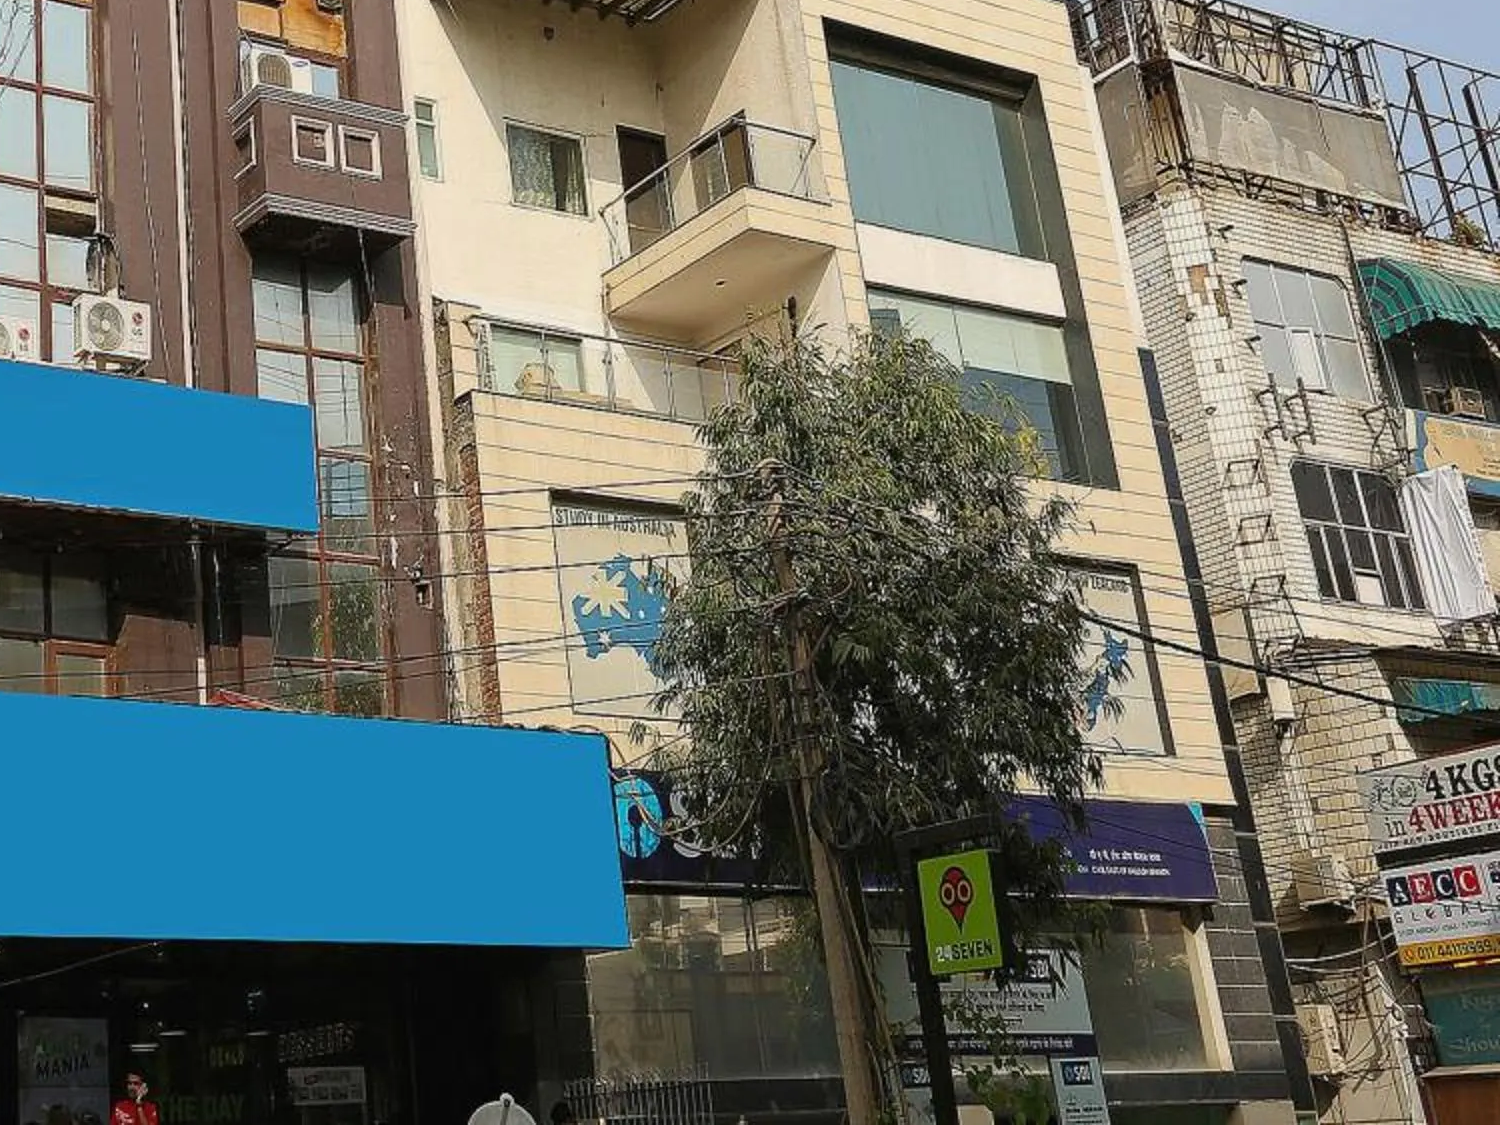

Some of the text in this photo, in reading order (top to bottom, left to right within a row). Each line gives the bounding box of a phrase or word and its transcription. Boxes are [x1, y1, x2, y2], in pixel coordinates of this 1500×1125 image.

[1385, 816, 1407, 838] in
[1390, 867, 1480, 905] AECC
[35, 1049, 91, 1079] MANIA
